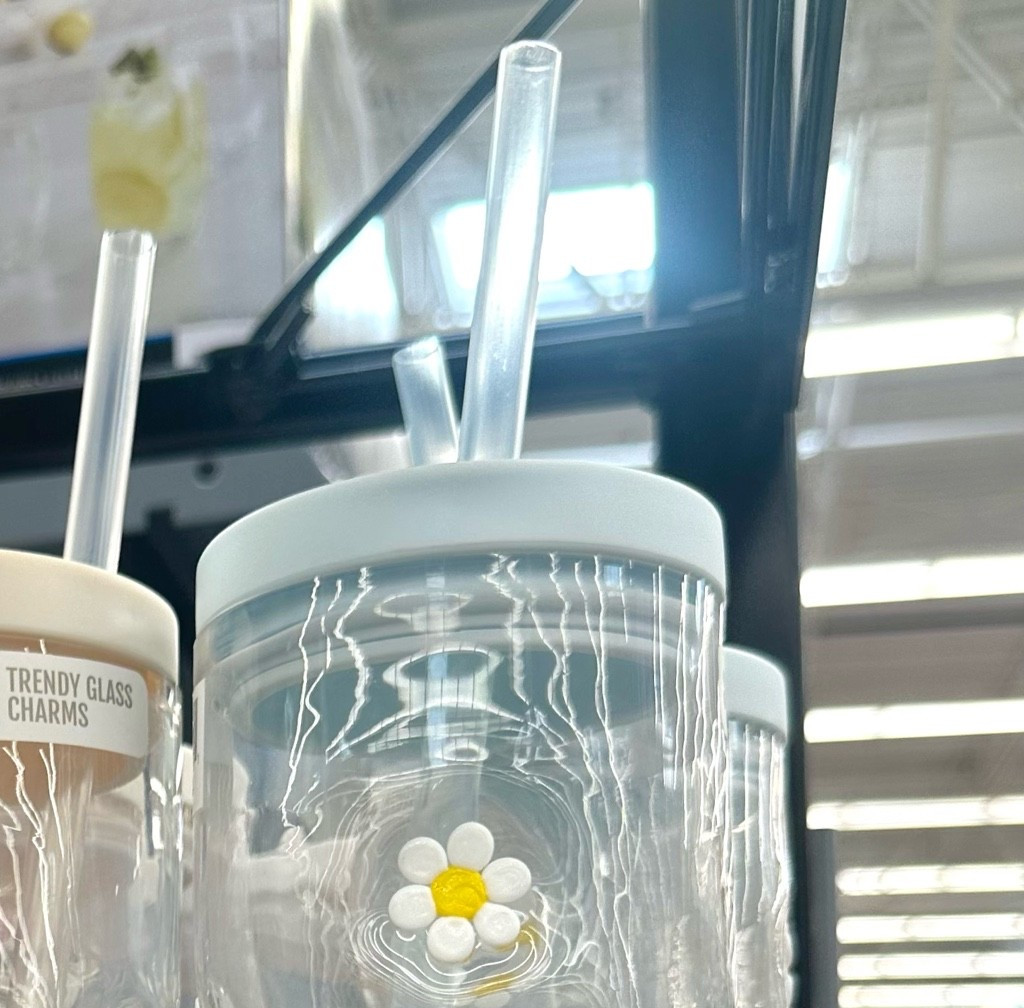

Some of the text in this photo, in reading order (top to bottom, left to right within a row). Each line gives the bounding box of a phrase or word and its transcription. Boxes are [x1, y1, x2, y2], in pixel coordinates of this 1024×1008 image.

[6, 667, 132, 708] TRENDY GLASS
[8, 696, 88, 727] CHARMS
